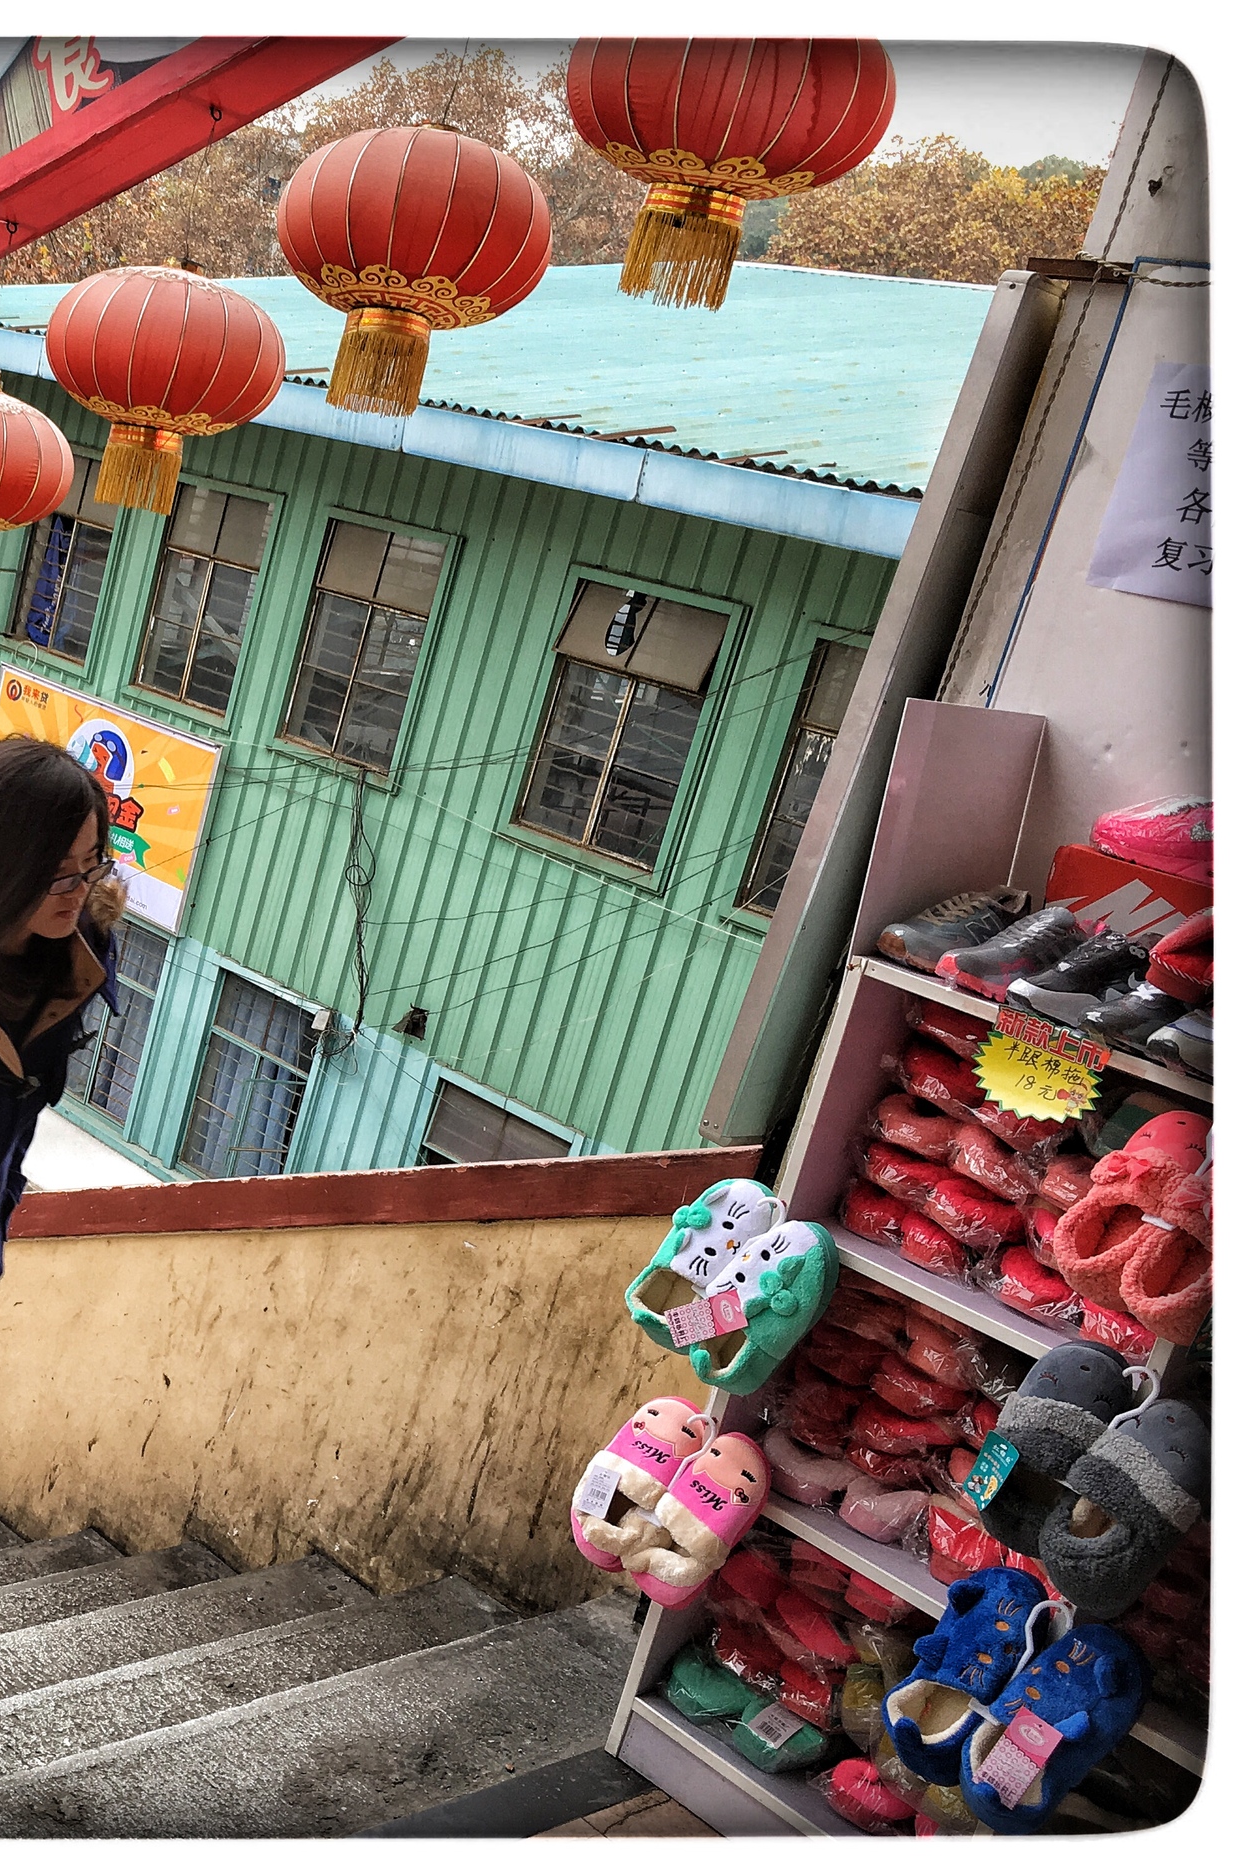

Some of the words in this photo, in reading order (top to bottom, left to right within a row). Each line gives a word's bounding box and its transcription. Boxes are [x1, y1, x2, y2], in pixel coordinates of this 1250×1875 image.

[1187, 438, 1212, 472] 等
[1176, 487, 1212, 524] 各
[994, 1008, 1107, 1072] 新款上市
[1015, 1074, 1058, 1101] 18元
[632, 1440, 670, 1464] Miss
[690, 1480, 728, 1511] Miss
